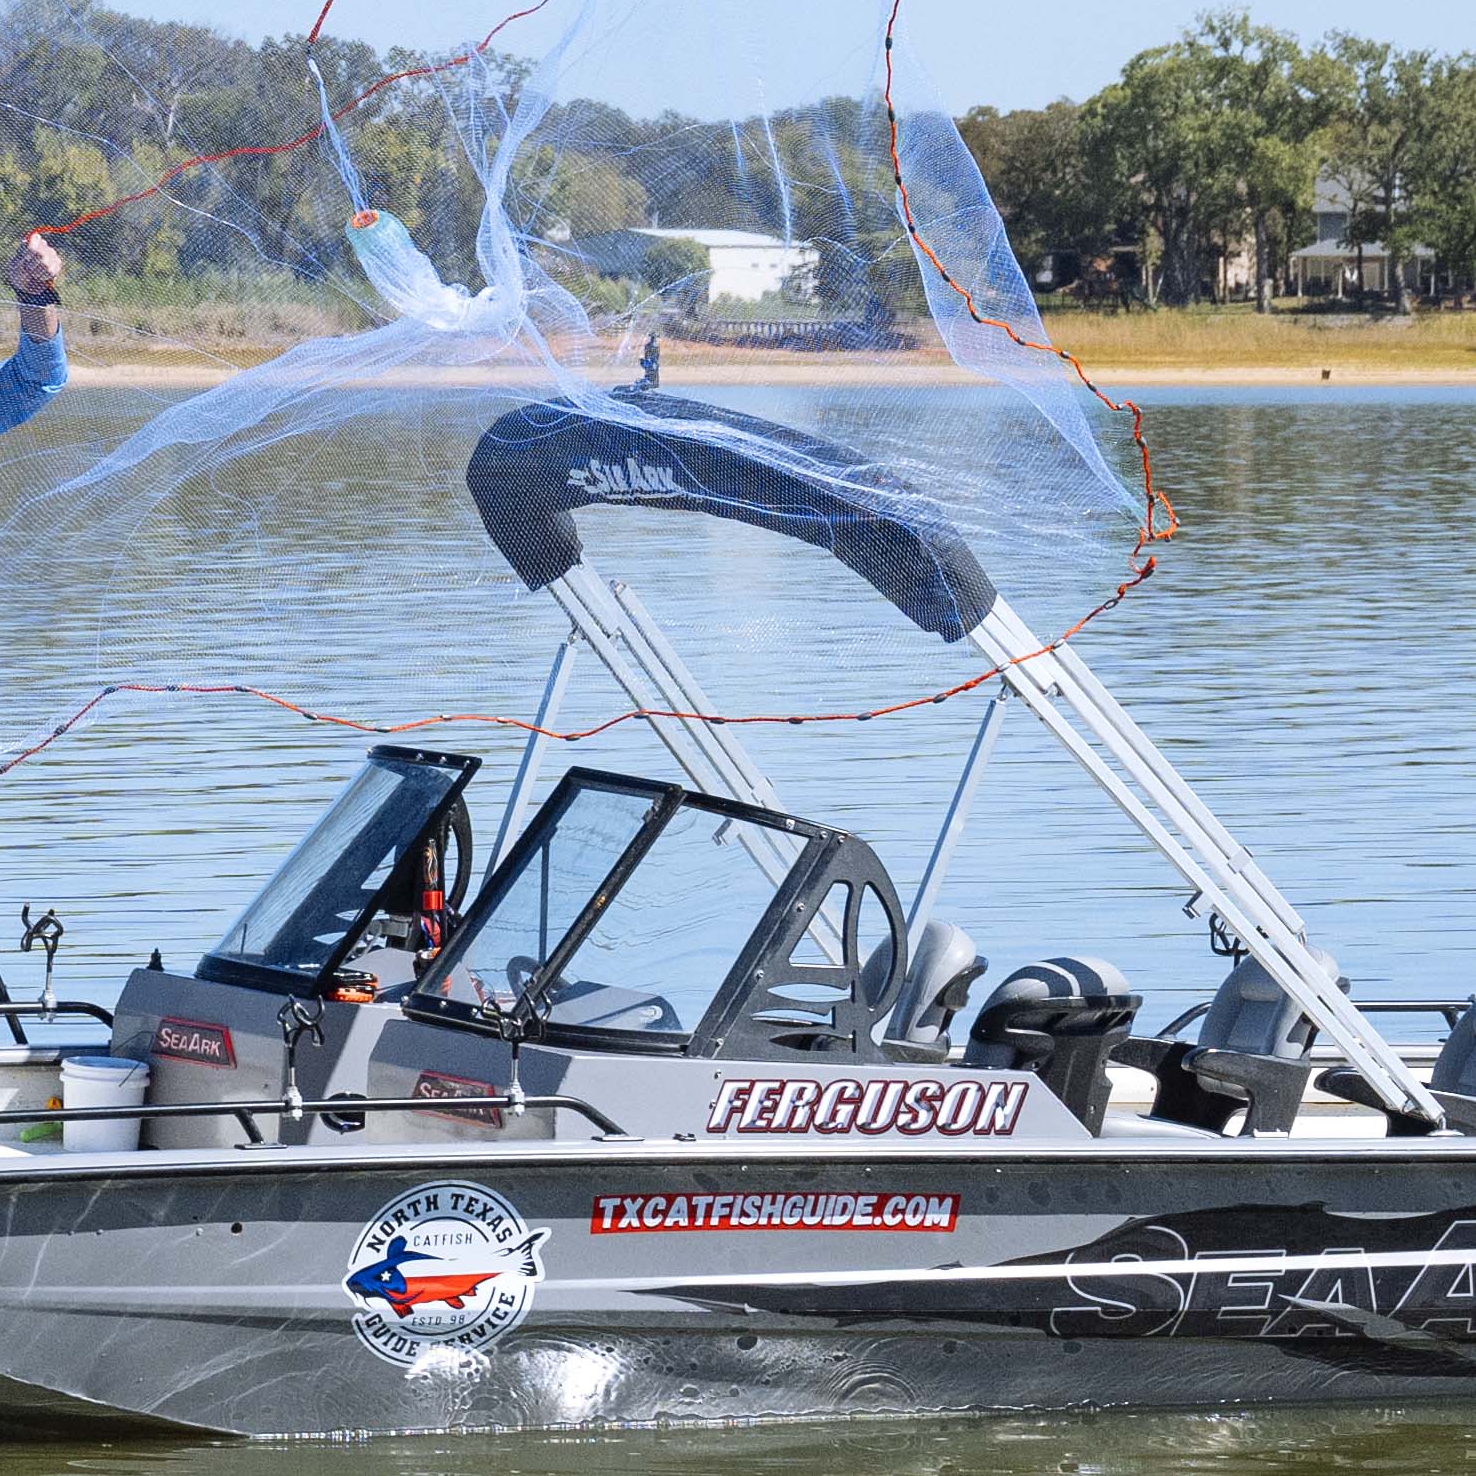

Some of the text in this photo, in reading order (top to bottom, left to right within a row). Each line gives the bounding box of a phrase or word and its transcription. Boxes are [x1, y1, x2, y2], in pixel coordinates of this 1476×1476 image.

[706, 1078, 1030, 1136] FERGUSON
[366, 1193, 513, 1253] NORTH TEXAS
[598, 1194, 953, 1230] TXCATFISHGUIDE.COM
[413, 1233, 473, 1247] CATFISH
[365, 1313, 421, 1357] GUIDE
